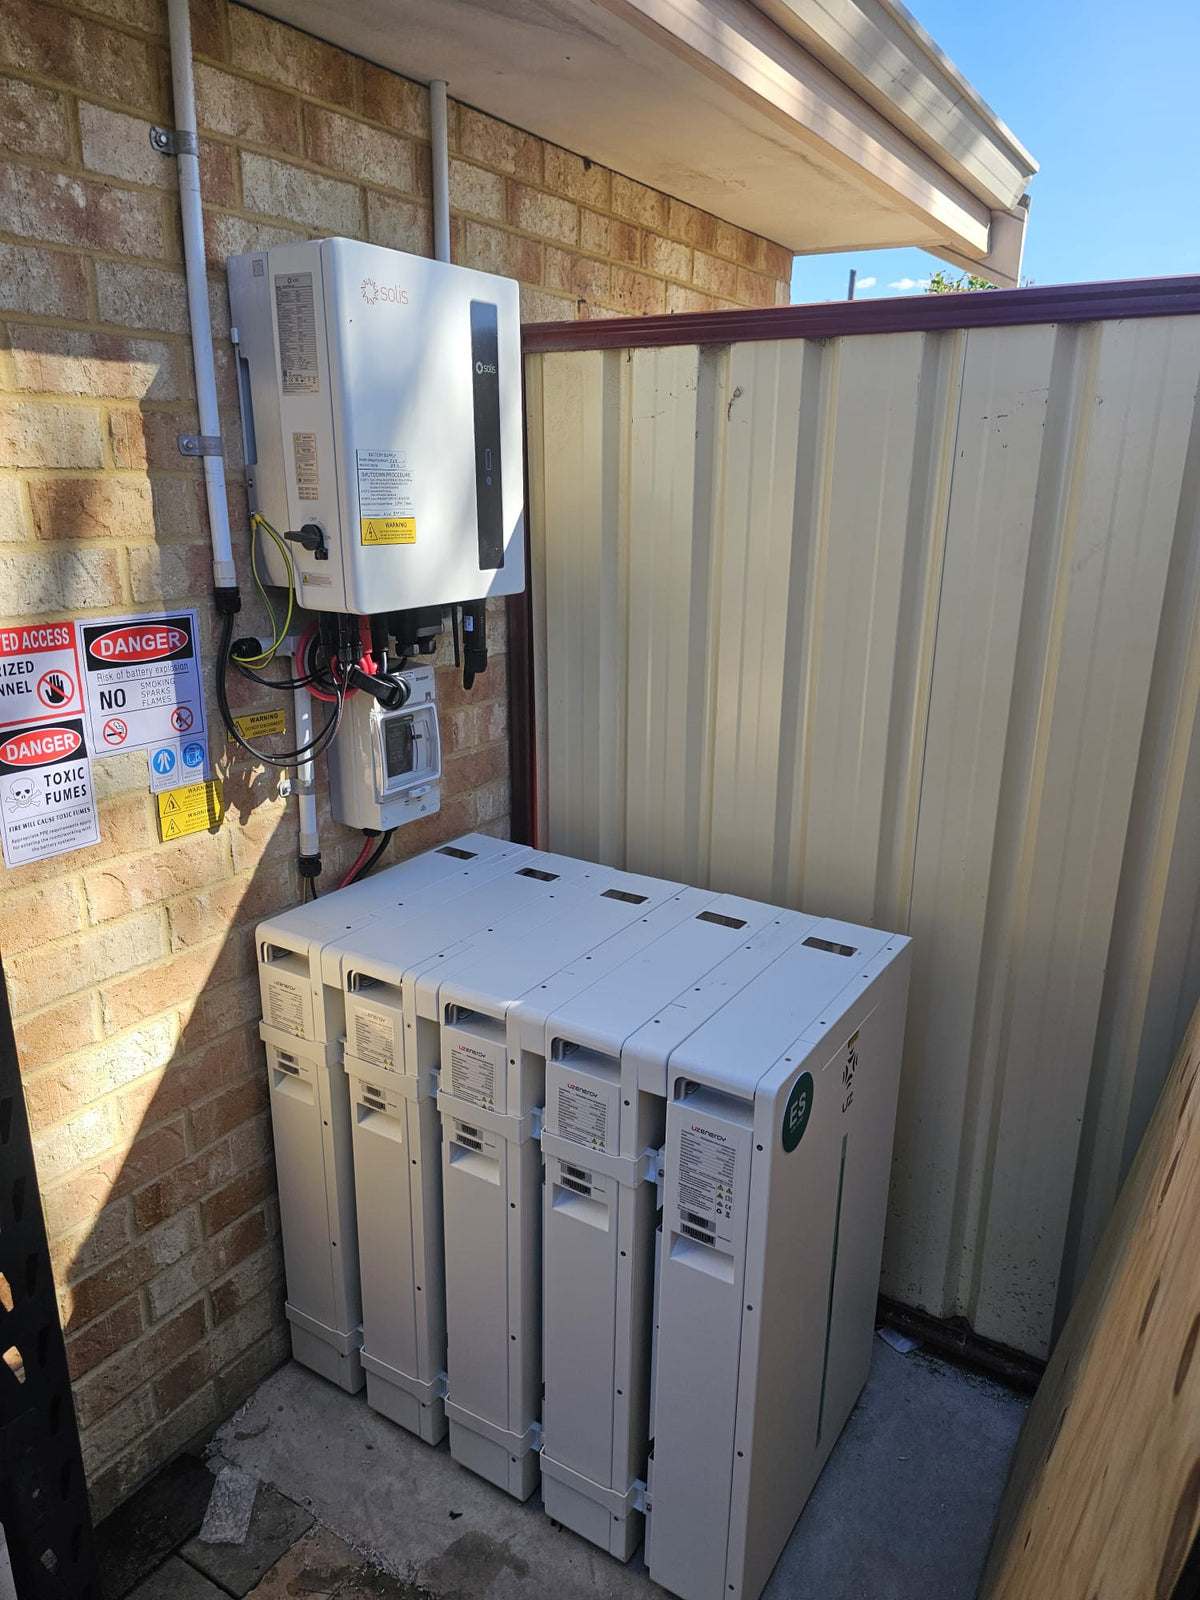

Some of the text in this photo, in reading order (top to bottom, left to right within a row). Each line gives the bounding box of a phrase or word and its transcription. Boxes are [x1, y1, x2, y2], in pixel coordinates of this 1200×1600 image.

[380, 285, 409, 305] solis
[483, 364, 497, 374] solis
[0, 627, 70, 652] ED ACCESS
[100, 631, 181, 657] DANGER
[0, 660, 34, 677] IZED
[96, 662, 189, 682] Risk of battery explosion
[0, 680, 33, 697] NNEL
[140, 677, 176, 690] SMOKING
[141, 687, 171, 699] SPARKS
[99, 688, 127, 711] NO
[142, 695, 173, 707] FLAMES
[250, 712, 279, 723] WARNING
[6, 732, 77, 761] DANGER
[43, 766, 85, 788] TOXIC
[45, 784, 88, 805] FUMES
[9, 807, 91, 833] FIRE WILL CAUSE TOXIC FUMES
[789, 1091, 807, 1129] ES
